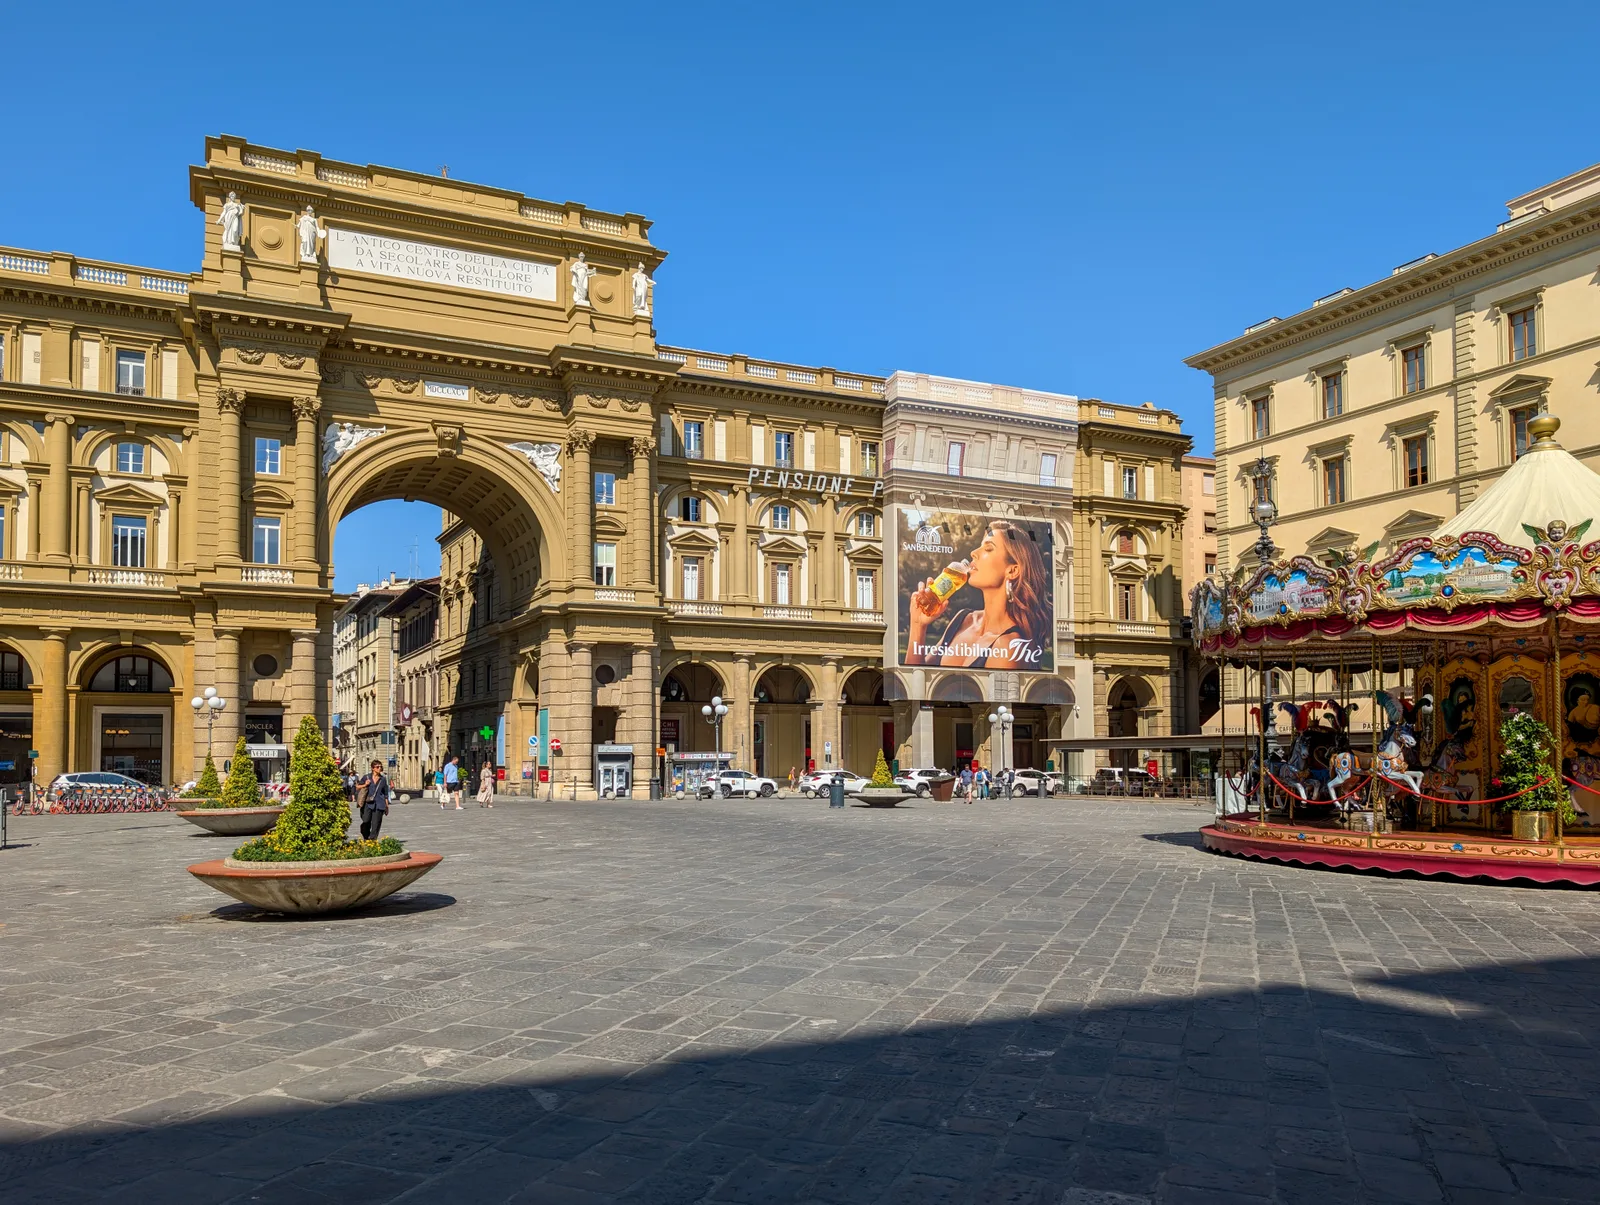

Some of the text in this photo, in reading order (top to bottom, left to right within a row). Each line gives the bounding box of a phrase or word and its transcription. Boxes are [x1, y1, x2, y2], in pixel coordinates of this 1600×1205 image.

[352, 235, 401, 251] ANTICO
[406, 243, 459, 260] CENTRO
[465, 253, 507, 269] DELLA
[356, 246, 532, 284] DA SECOLARE SQUALLORE
[356, 258, 533, 294] A VITA NUOVA RESTITUITO
[748, 467, 855, 495] PENSIONE
